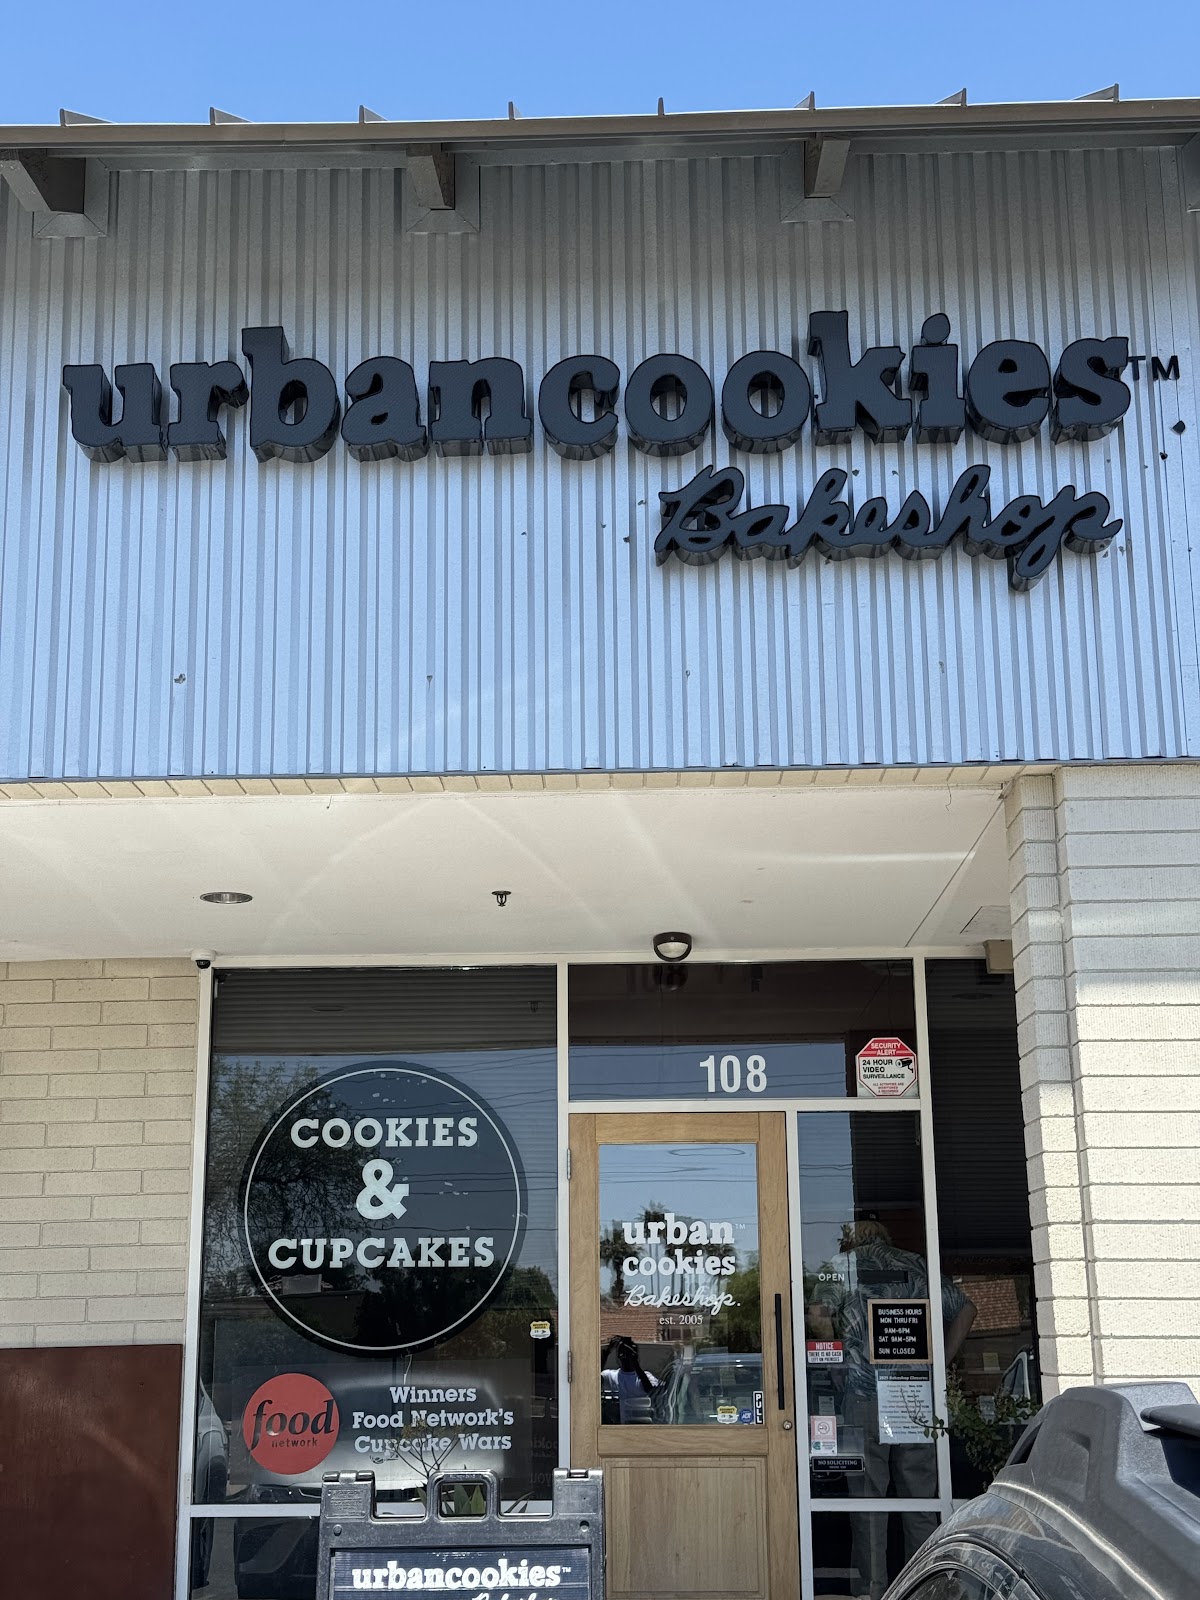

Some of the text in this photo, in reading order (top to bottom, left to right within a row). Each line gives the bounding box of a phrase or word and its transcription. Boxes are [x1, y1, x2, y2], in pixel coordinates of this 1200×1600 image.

[62, 311, 1132, 462] urbancookies
[655, 464, 1124, 592] Bakeshop
[699, 1055, 767, 1093] 108
[290, 1117, 478, 1148] COOKIES
[355, 1158, 409, 1219] &
[622, 1212, 734, 1245] urban
[267, 1236, 495, 1269] CUPCAKES
[622, 1248, 736, 1276] cookies
[818, 1273, 845, 1281] OPEN
[678, 1314, 704, 1325] 2005
[390, 1386, 477, 1403] Winners
[251, 1400, 335, 1449] food
[353, 1408, 514, 1428] Food Network's
[271, 1438, 318, 1448] network
[354, 1432, 512, 1454] Cupcake Wars
[351, 1559, 562, 1589] urbancookies
